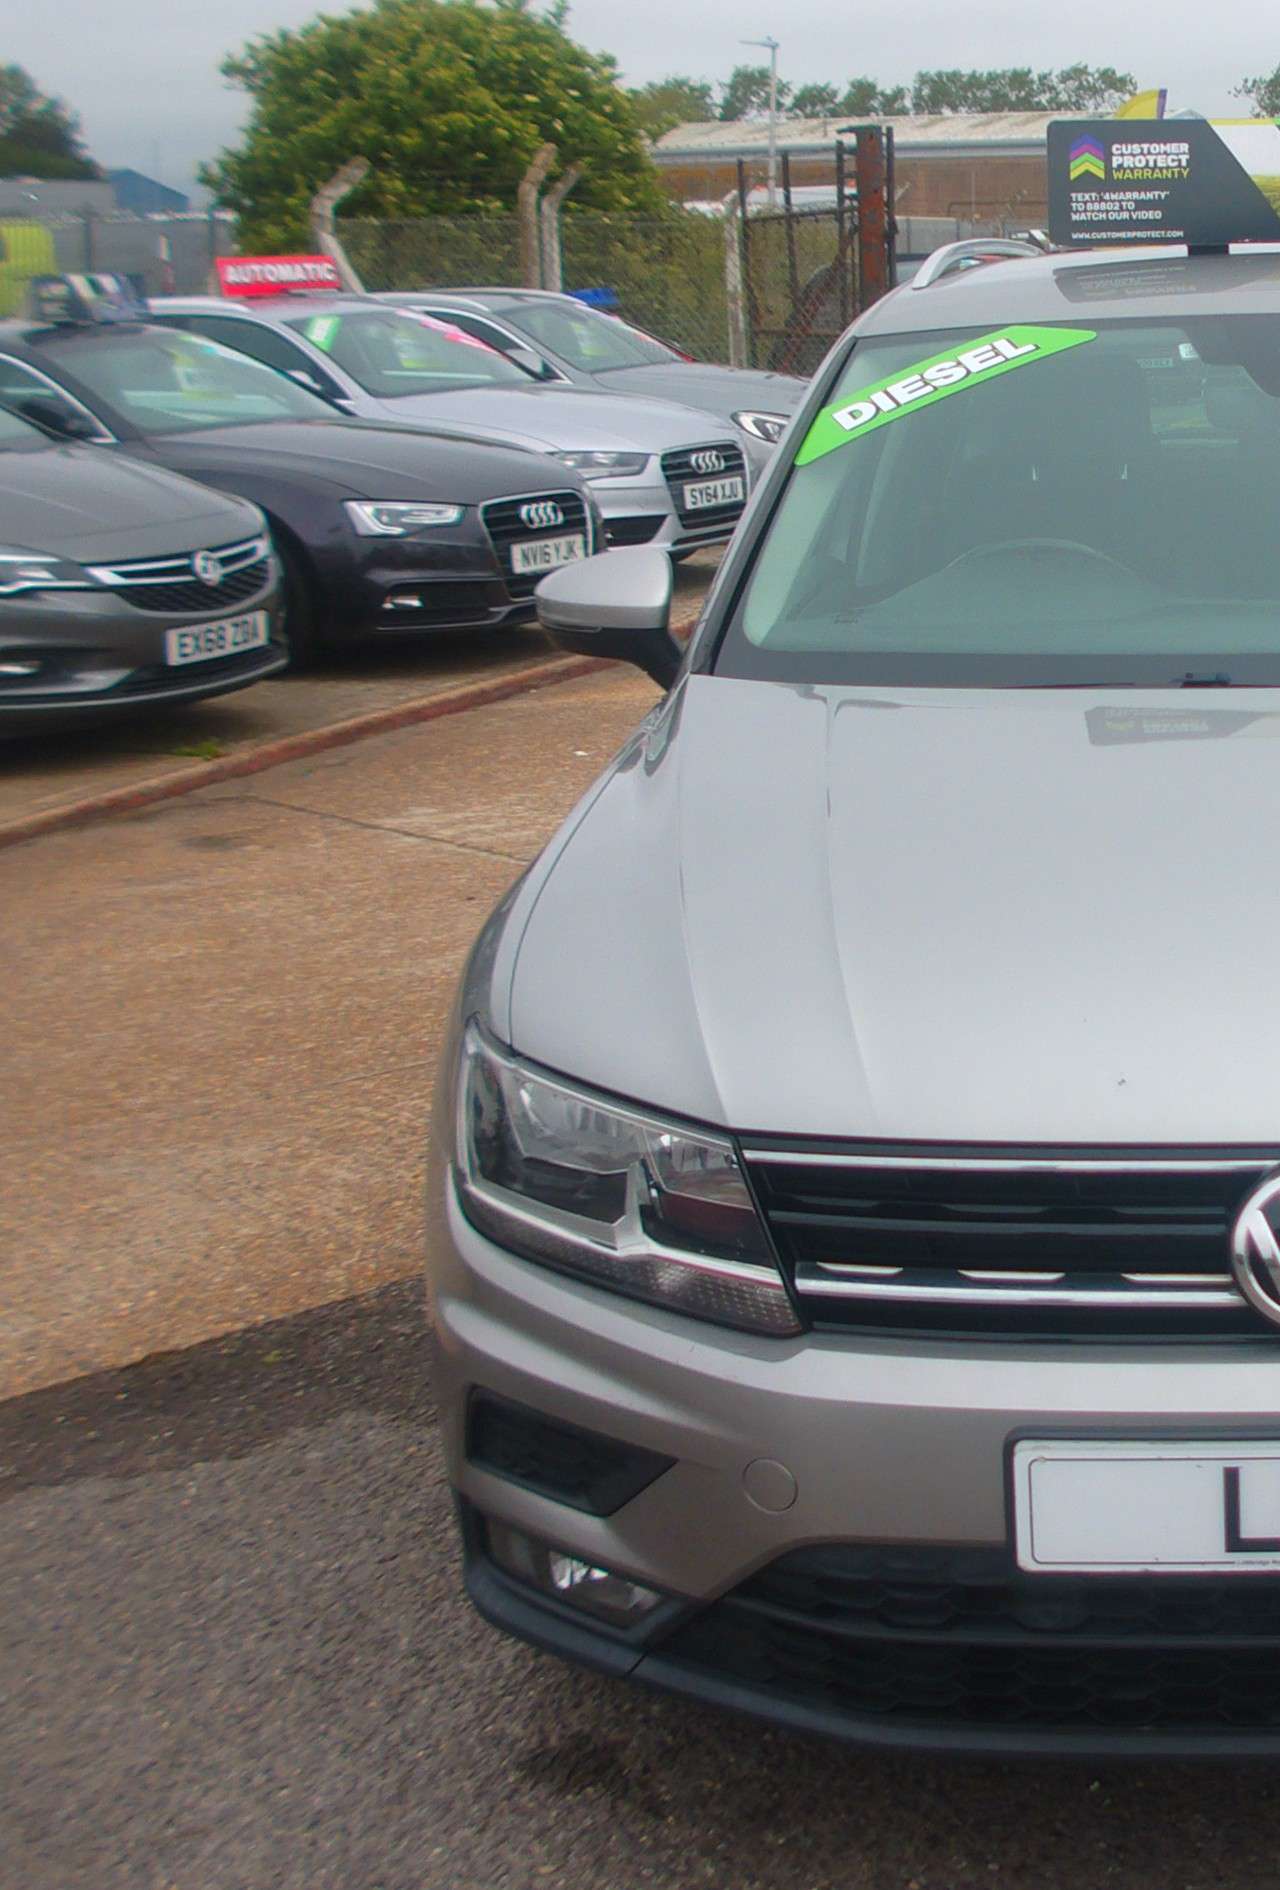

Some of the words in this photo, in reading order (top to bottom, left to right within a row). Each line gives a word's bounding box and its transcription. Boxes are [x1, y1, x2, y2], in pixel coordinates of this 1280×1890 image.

[1111, 142, 1189, 155] CUSTOMER
[1111, 155, 1190, 168] PROTECT
[1112, 168, 1190, 180] WARRANTY
[1071, 202, 1085, 212] TO
[1121, 201, 1135, 210] TO
[1071, 211, 1107, 221] WATCH
[1108, 210, 1130, 220] OUR
[1131, 210, 1162, 219] VIDEO
[224, 262, 337, 284] AUTOMATIC
[831, 337, 1041, 431] DIESEL
[690, 484, 718, 506] SY64
[520, 543, 551, 567] NV16
[553, 540, 579, 563] YJK
[178, 624, 226, 657] EX68
